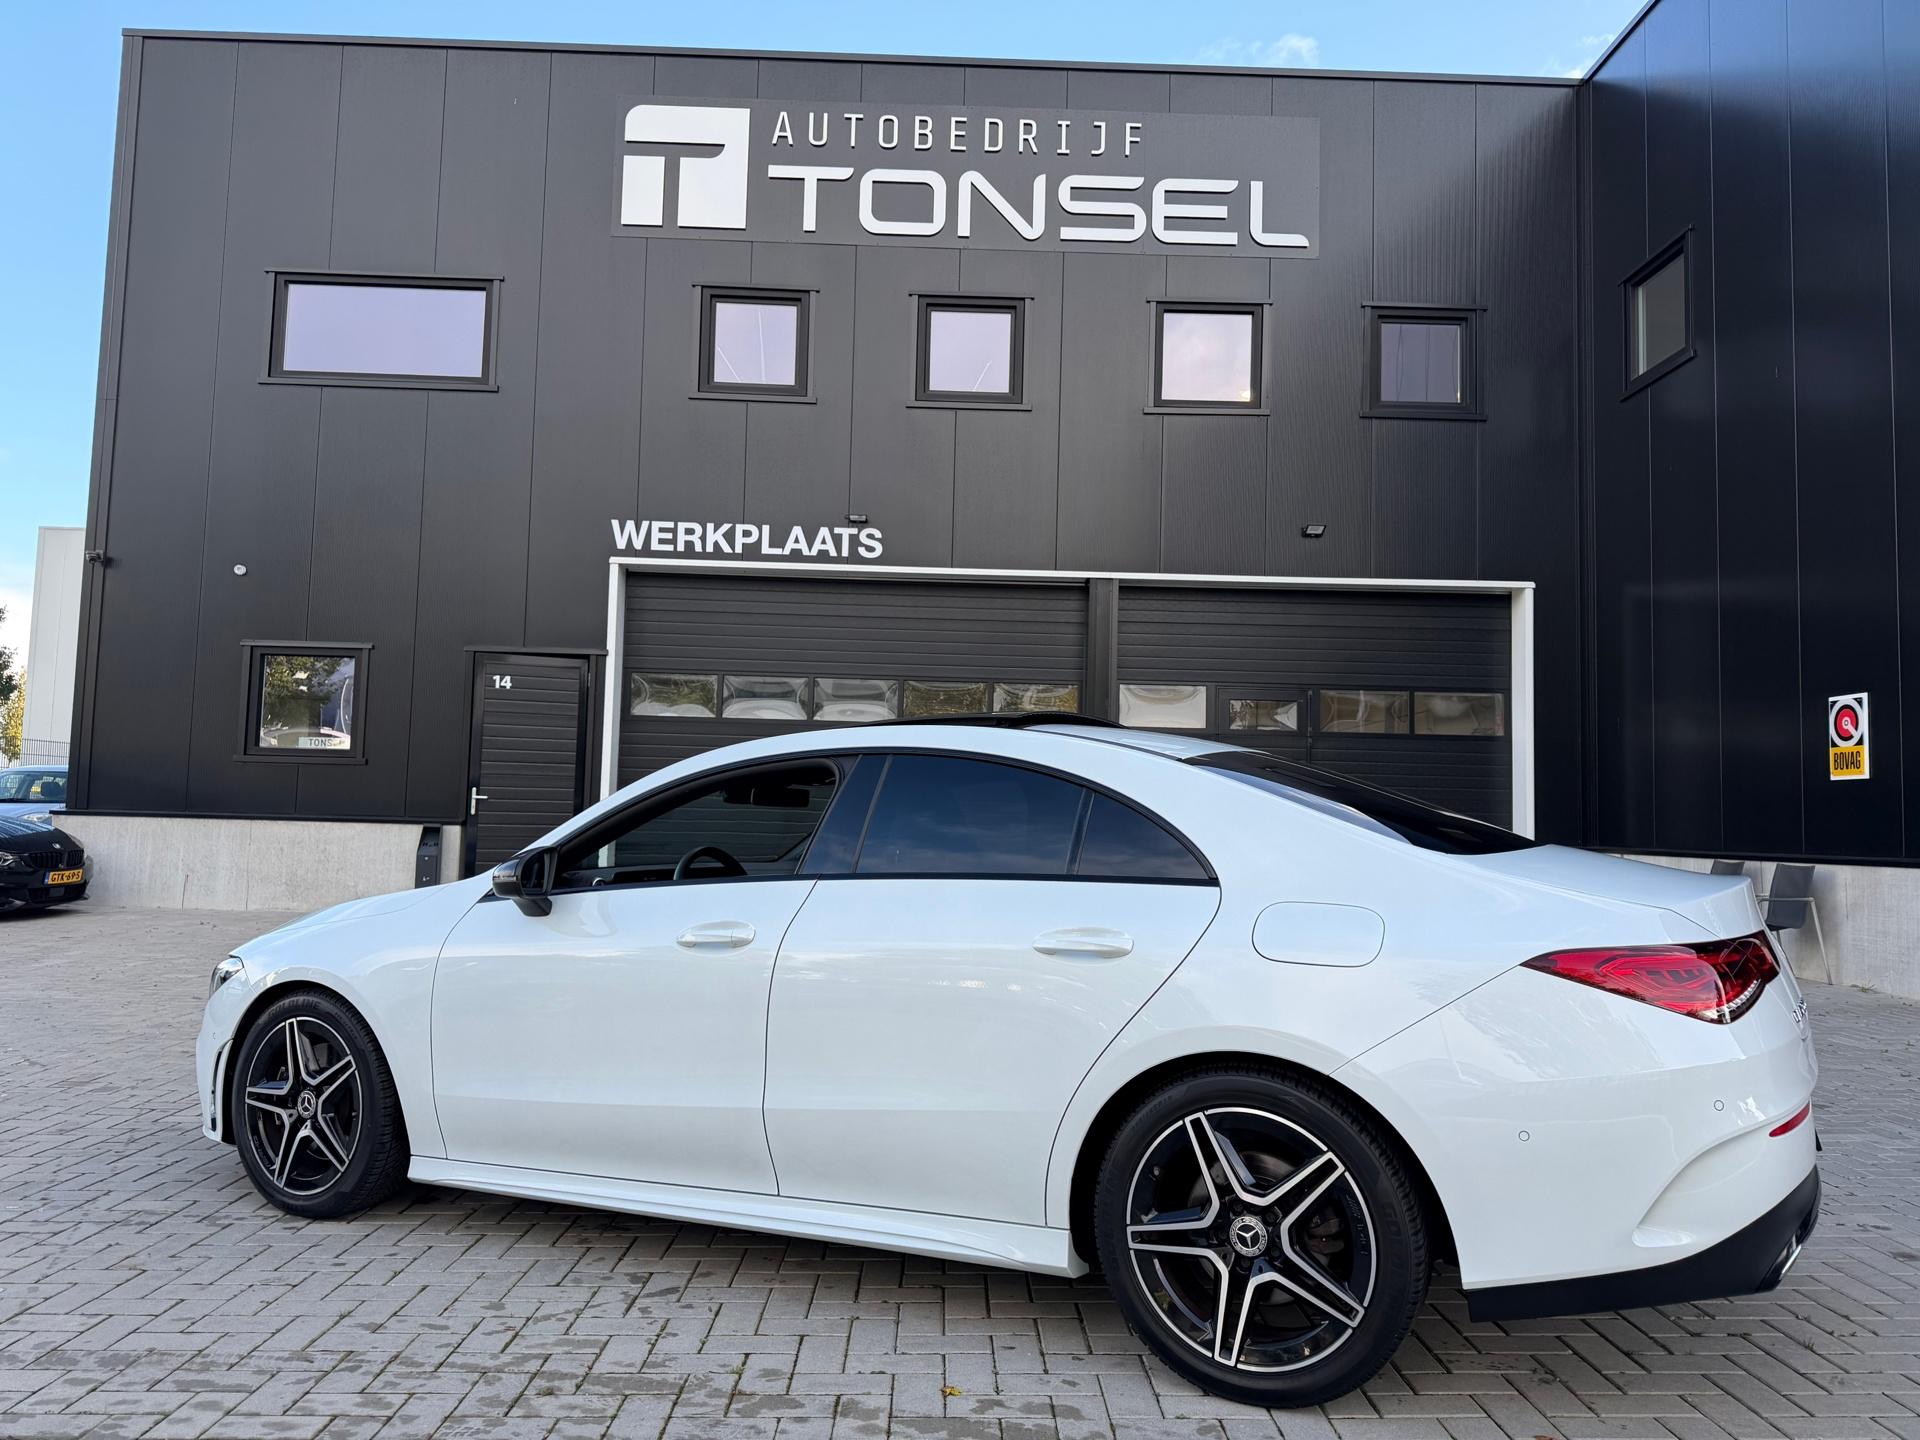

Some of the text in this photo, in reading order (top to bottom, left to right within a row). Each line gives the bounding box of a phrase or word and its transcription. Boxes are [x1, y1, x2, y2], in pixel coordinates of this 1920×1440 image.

[772, 111, 1143, 156] AUTOBEDRIJF
[767, 165, 1310, 247] TONSEL
[611, 519, 883, 559] WERKPLAATS
[492, 675, 512, 690] 14
[1833, 750, 1860, 771] BOVAG
